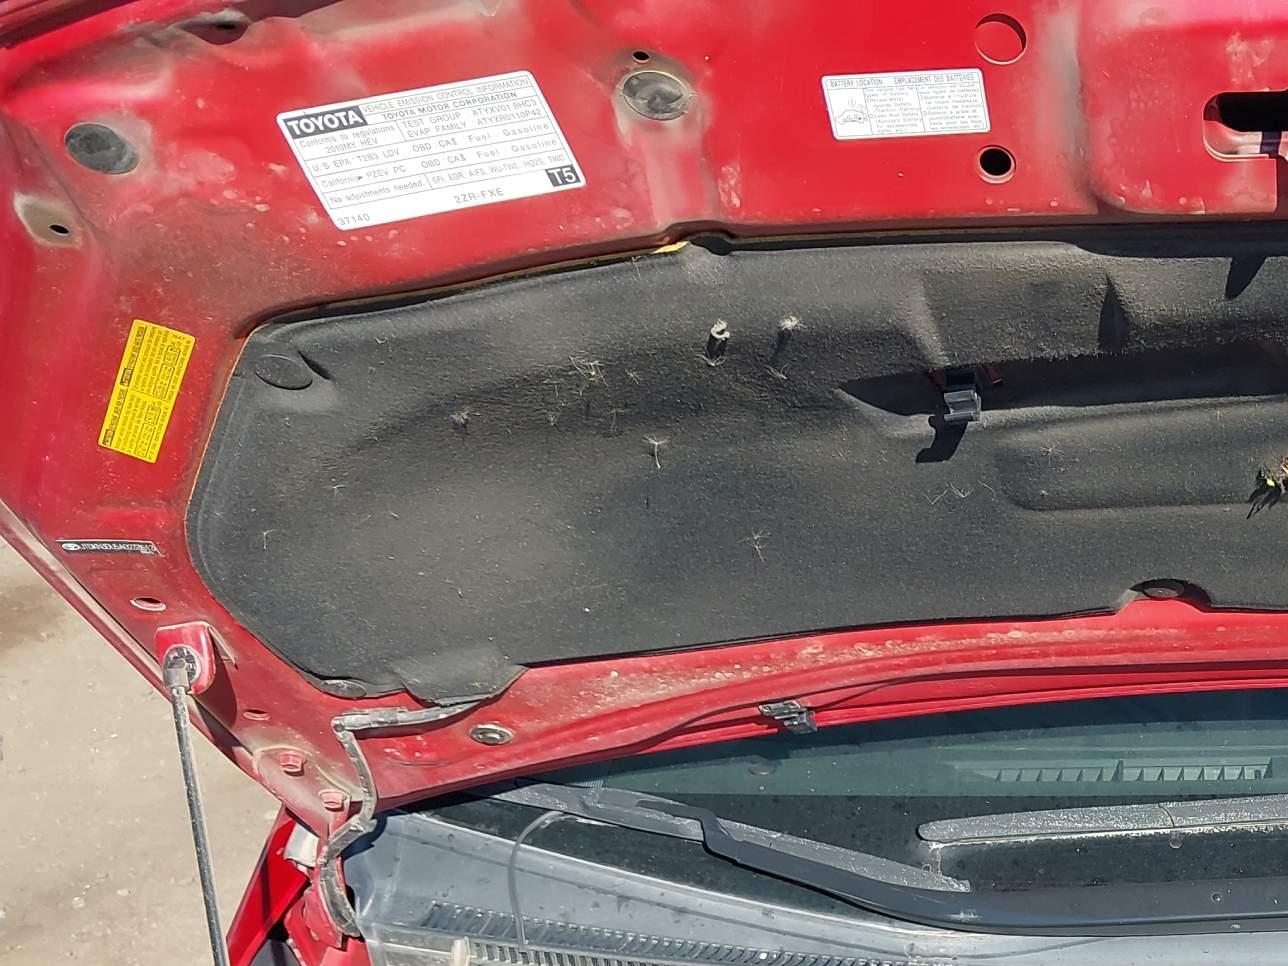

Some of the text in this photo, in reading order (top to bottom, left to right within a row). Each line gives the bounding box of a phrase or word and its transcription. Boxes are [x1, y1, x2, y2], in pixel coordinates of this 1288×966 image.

[829, 72, 975, 88] BATTERY LOCATION EMPLACEMENT DES BATTERIES
[360, 76, 530, 114] VEHICLE EMISSION CONTROL INFORMATION
[381, 90, 518, 121] TOYOTA MOTOR CORPORATION
[285, 108, 364, 136] TOYOTA
[400, 117, 426, 129] TEST
[427, 110, 463, 124] GROUP
[405, 126, 432, 138] EVAP
[433, 120, 469, 133] FAMILY
[297, 123, 397, 148] Conforms to regulations
[358, 136, 380, 147] HEV
[410, 142, 433, 153] OBD
[500, 120, 550, 137] Gasoline
[364, 167, 391, 179] PZEV
[391, 164, 408, 174] PC
[419, 157, 442, 169] OBD
[509, 136, 559, 153] Gasoline
[546, 165, 578, 186] T5
[343, 185, 392, 202] adjustments
[452, 186, 505, 205] 2ZR-FXE
[335, 212, 372, 227] 37140
